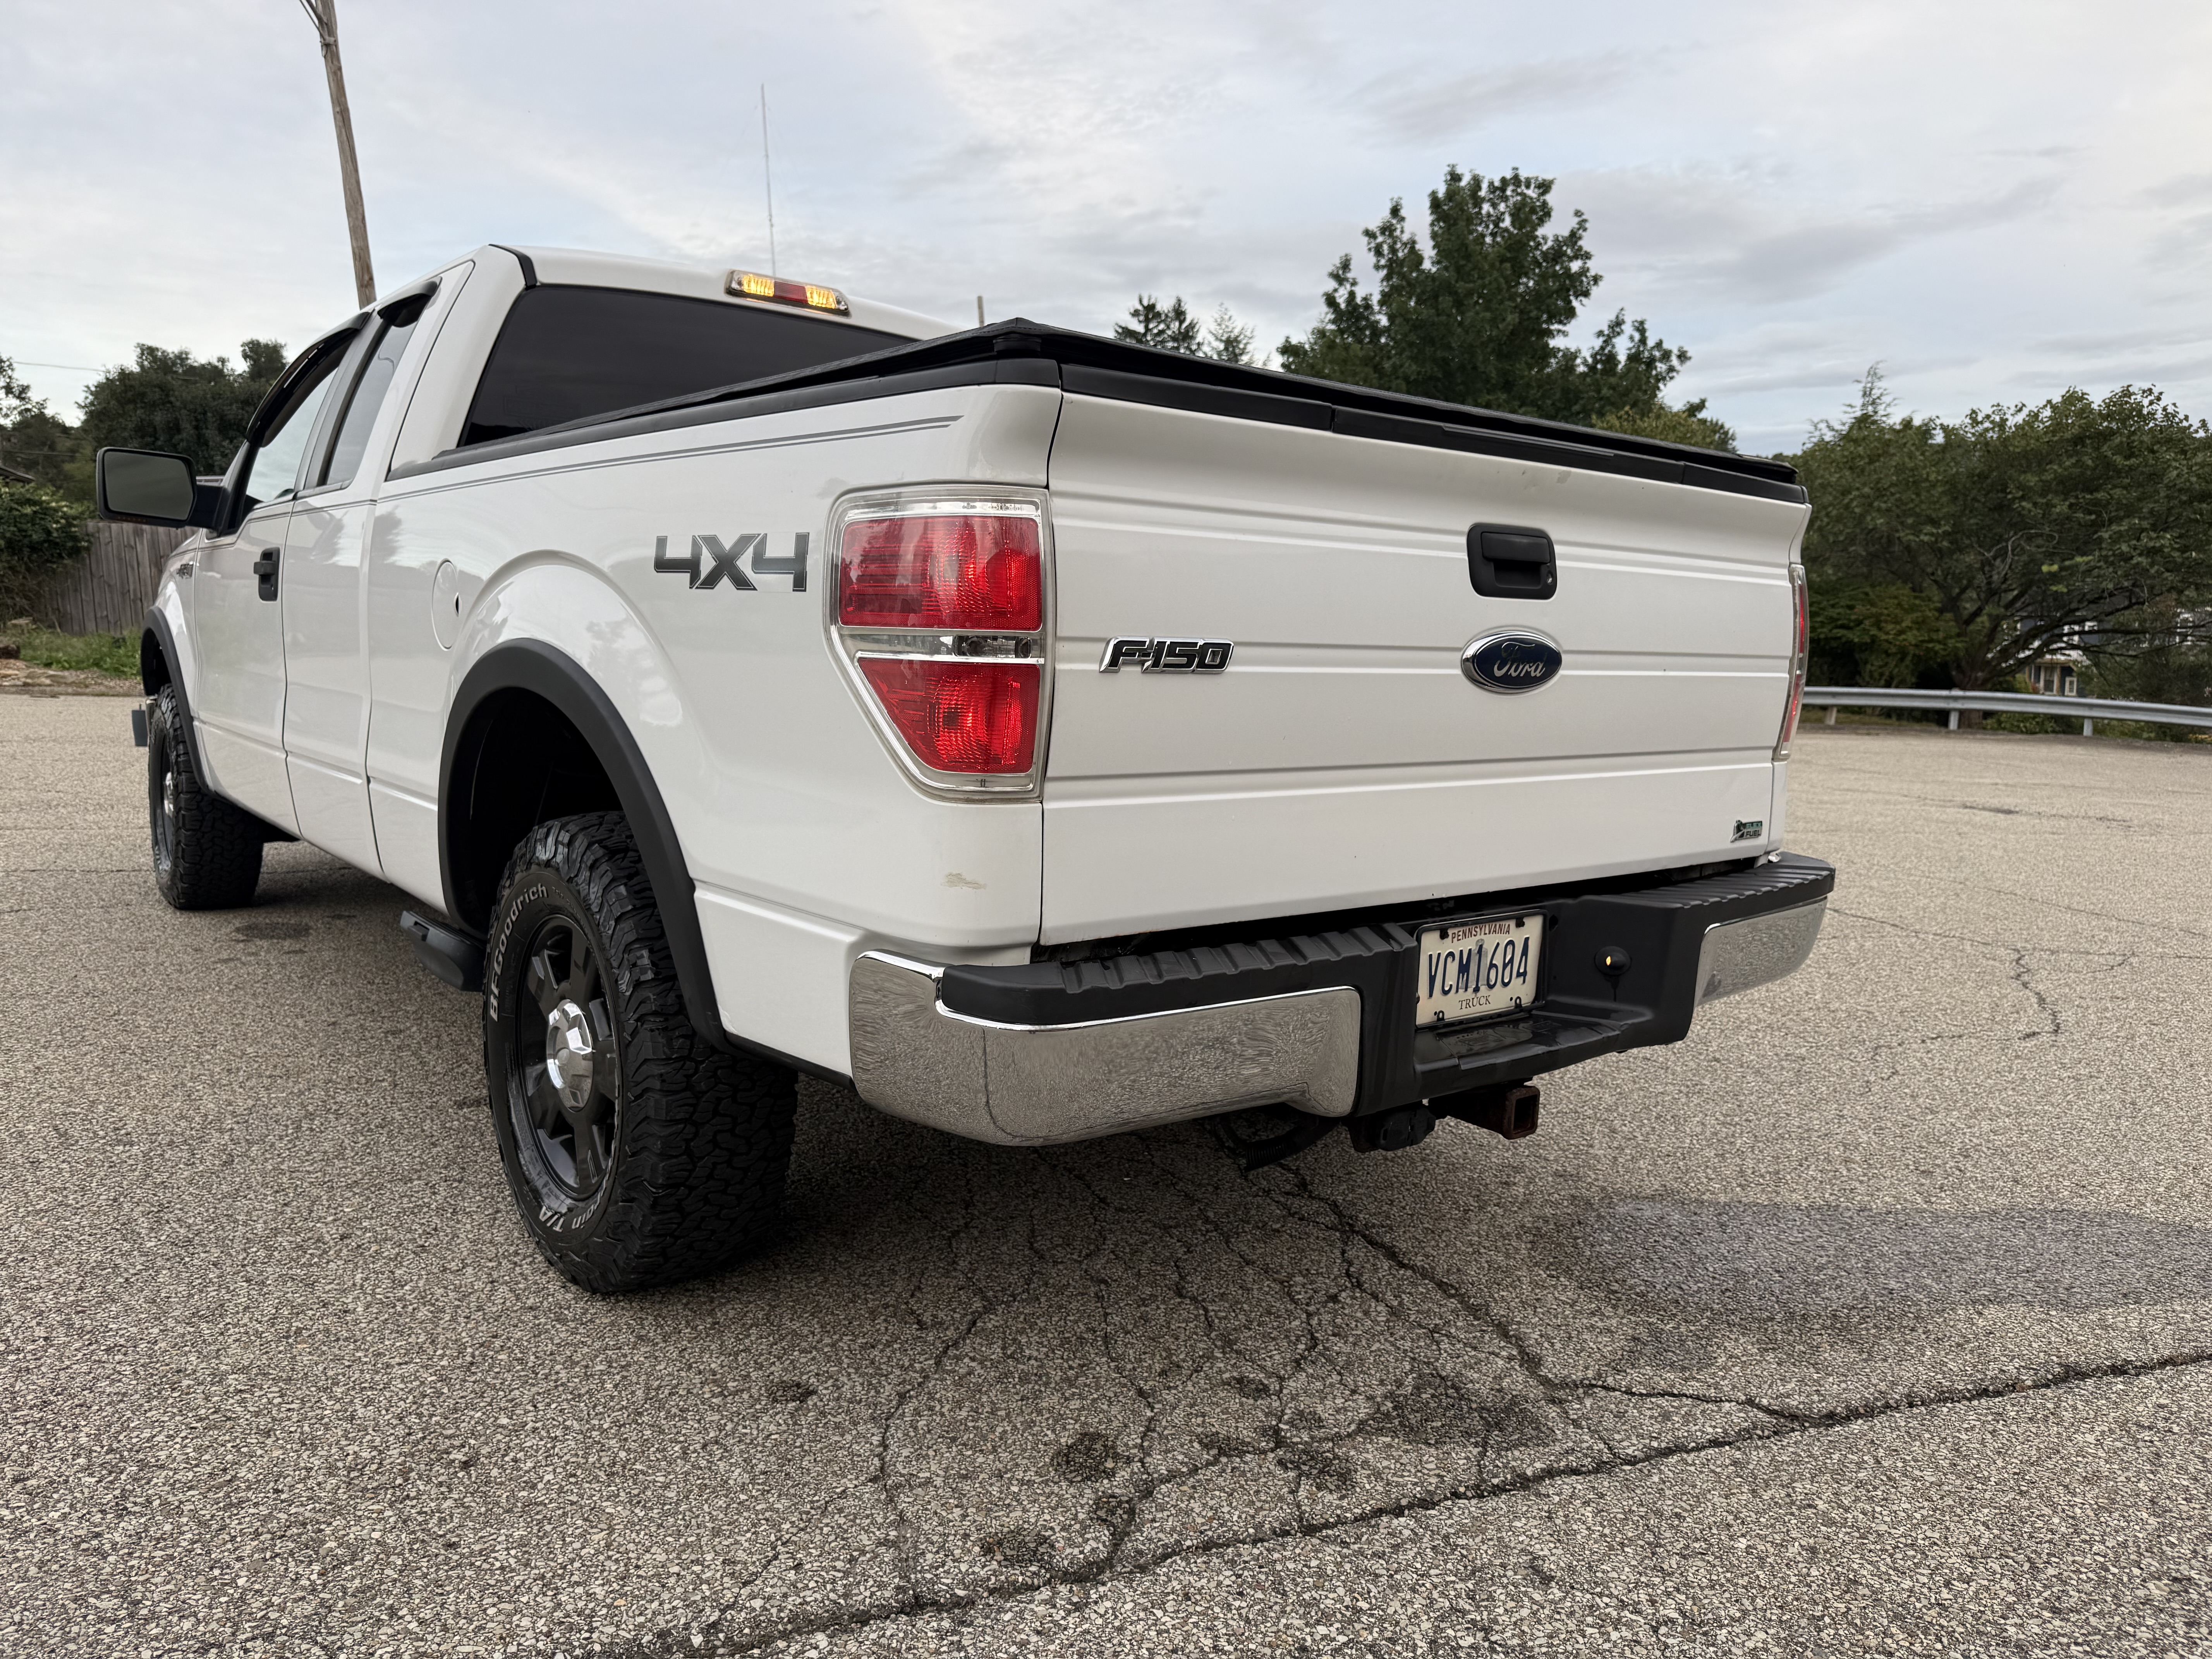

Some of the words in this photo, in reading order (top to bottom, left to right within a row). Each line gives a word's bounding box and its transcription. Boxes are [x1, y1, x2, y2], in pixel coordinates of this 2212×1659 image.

[1099, 636, 1235, 674] F-150
[1494, 642, 1547, 677] Ford
[1451, 923, 1511, 943] PENNSYLVANIA
[490, 883, 548, 1022] BFGoodrich
[1458, 995, 1491, 1010] TRUCK
